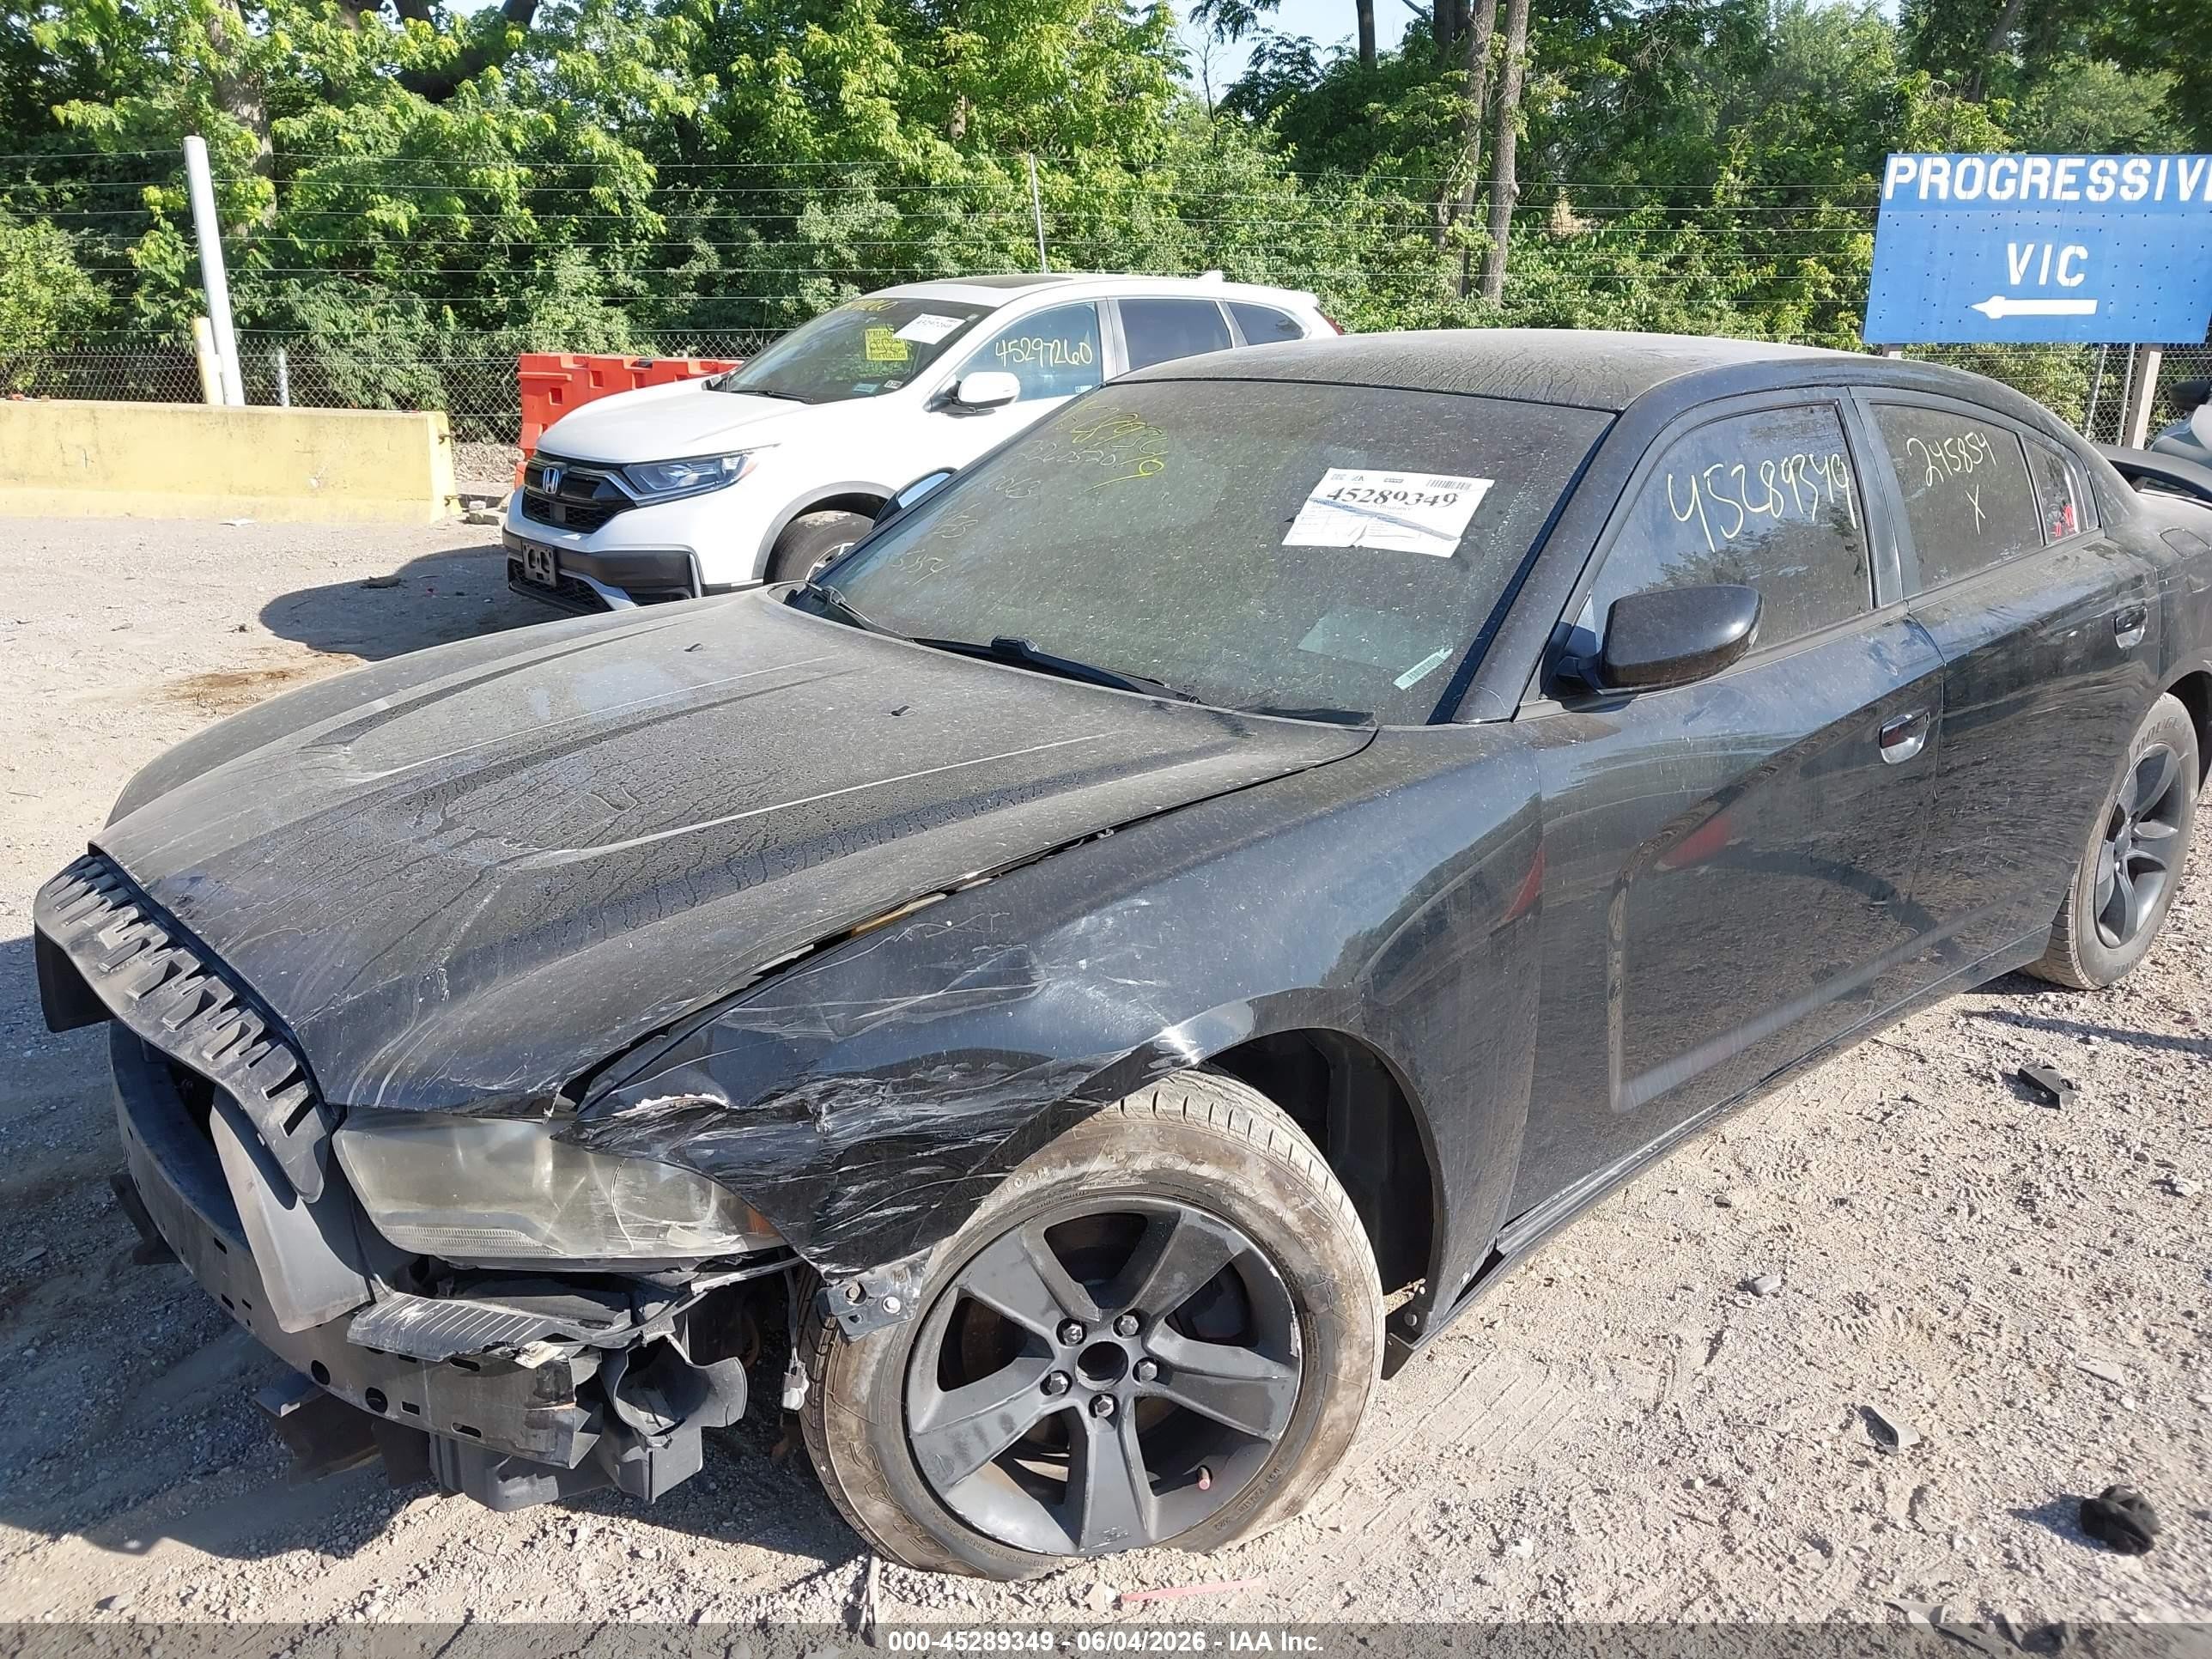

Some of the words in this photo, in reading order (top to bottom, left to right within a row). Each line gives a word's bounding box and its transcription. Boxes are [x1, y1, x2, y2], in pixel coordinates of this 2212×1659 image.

[1885, 157, 2212, 202] PROGRESSIV
[2008, 243, 2089, 288] VIC
[996, 337, 1092, 368] 45297260
[1906, 432, 1996, 487] 245854
[1327, 486, 1459, 508] 45289349
[1668, 453, 1857, 552] 45289349
[1965, 483, 1986, 535] X
